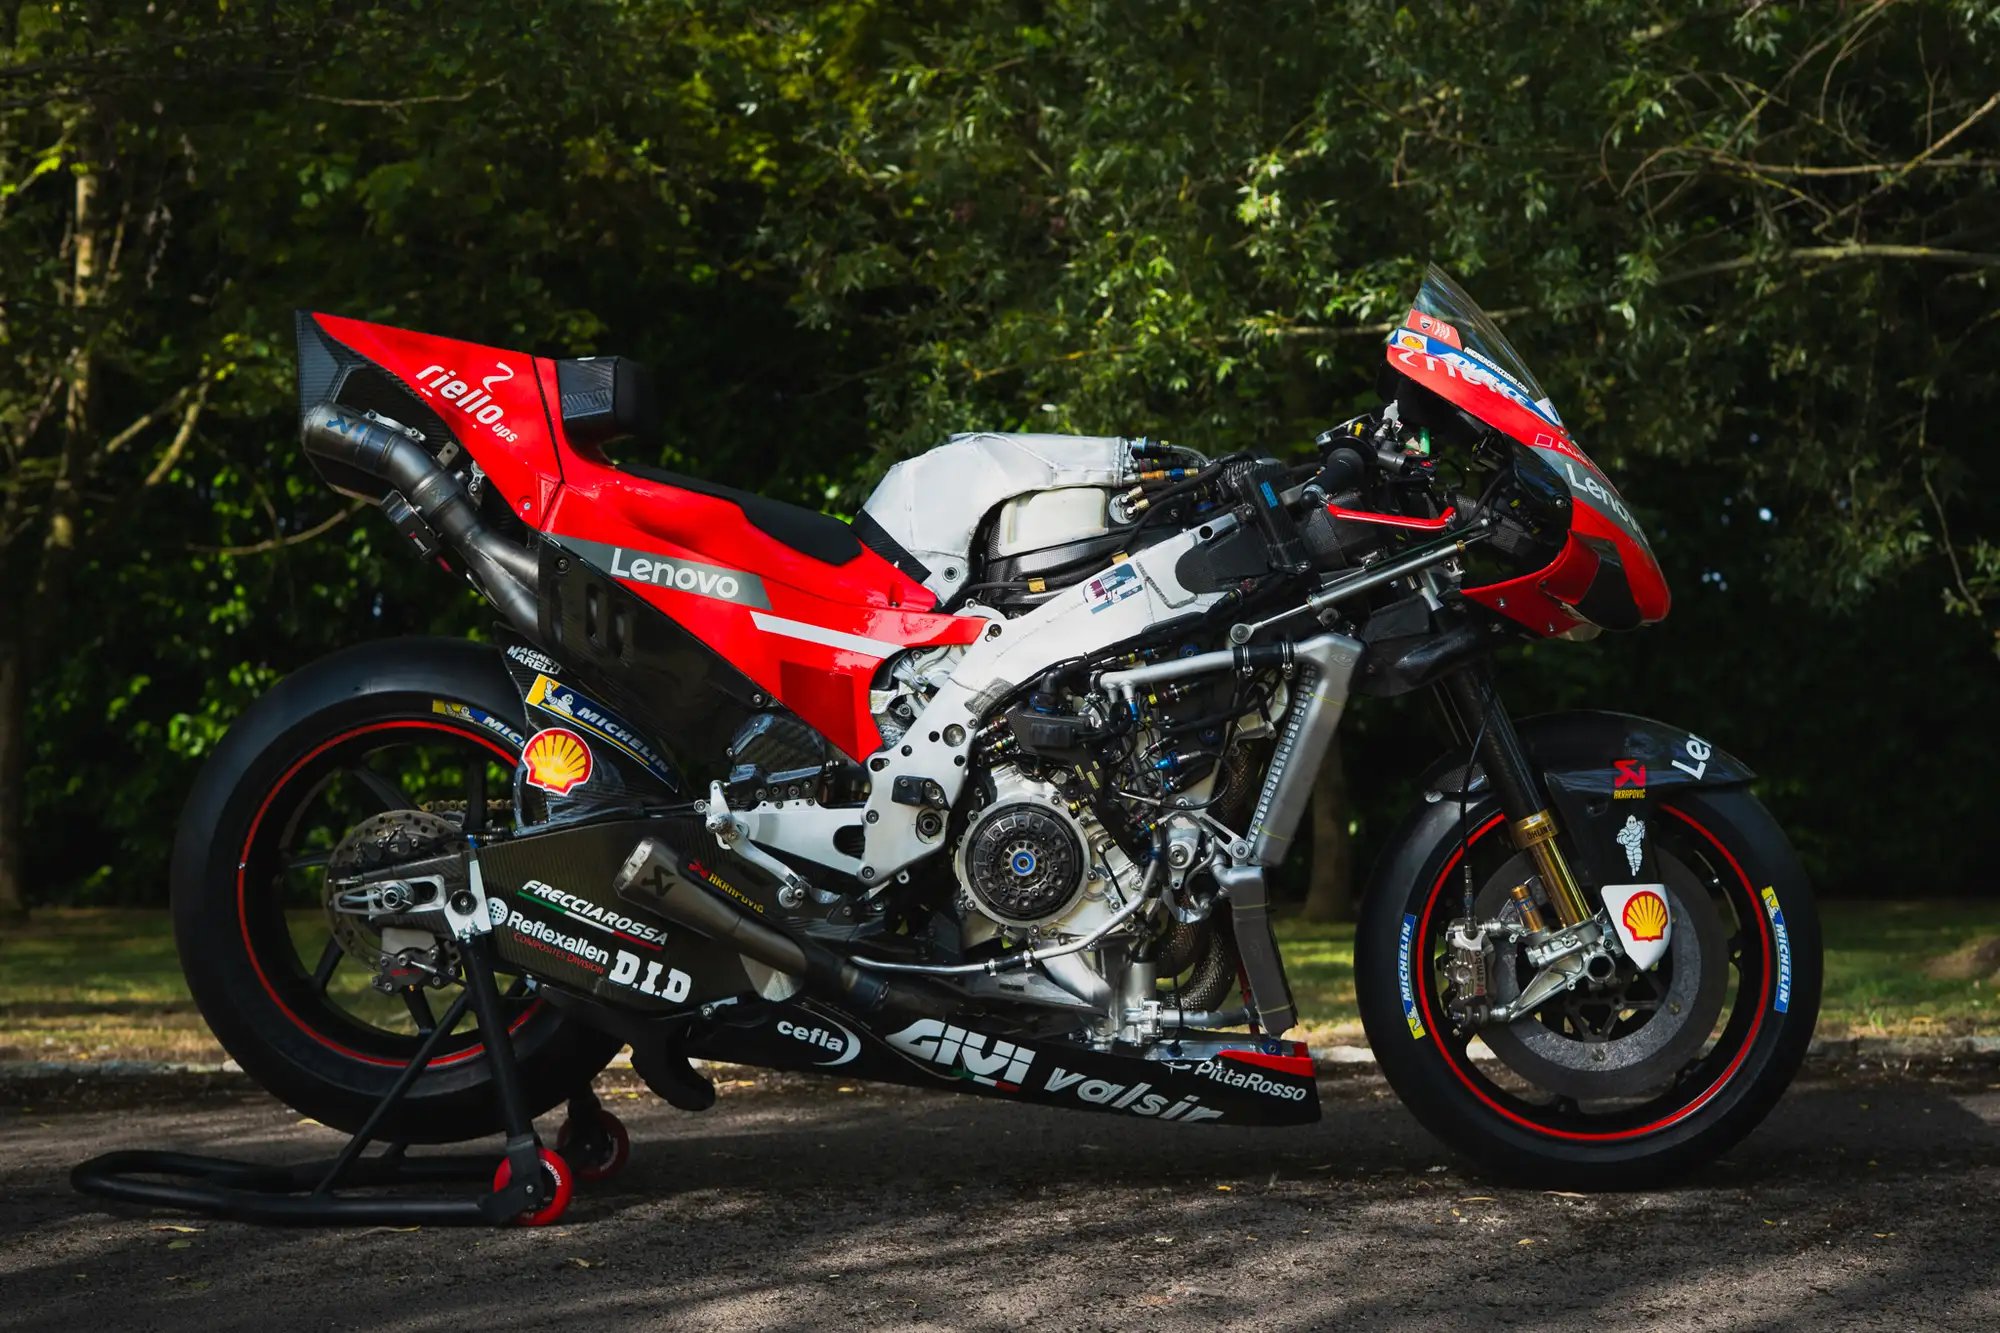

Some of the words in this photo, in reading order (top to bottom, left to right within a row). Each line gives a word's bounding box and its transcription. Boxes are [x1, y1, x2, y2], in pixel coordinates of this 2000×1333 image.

[416, 363, 505, 425] riello
[492, 422, 519, 444] ups
[610, 547, 740, 599] Lenovo
[577, 707, 670, 773] MICHELIN
[507, 910, 609, 966] Reflexallen
[522, 879, 669, 946] FRECCIAROSSA
[513, 932, 566, 960] COMPOSITES
[566, 952, 605, 975] DIVISION
[1399, 922, 1412, 1002] MICHELIN
[1474, 950, 1485, 995] brembo
[1775, 923, 1791, 1004] MICHELIN
[777, 1020, 844, 1052] cefla
[885, 1018, 1036, 1084] GIVI
[1043, 1067, 1225, 1122] valsir
[1194, 1060, 1307, 1101] PittaRosso
